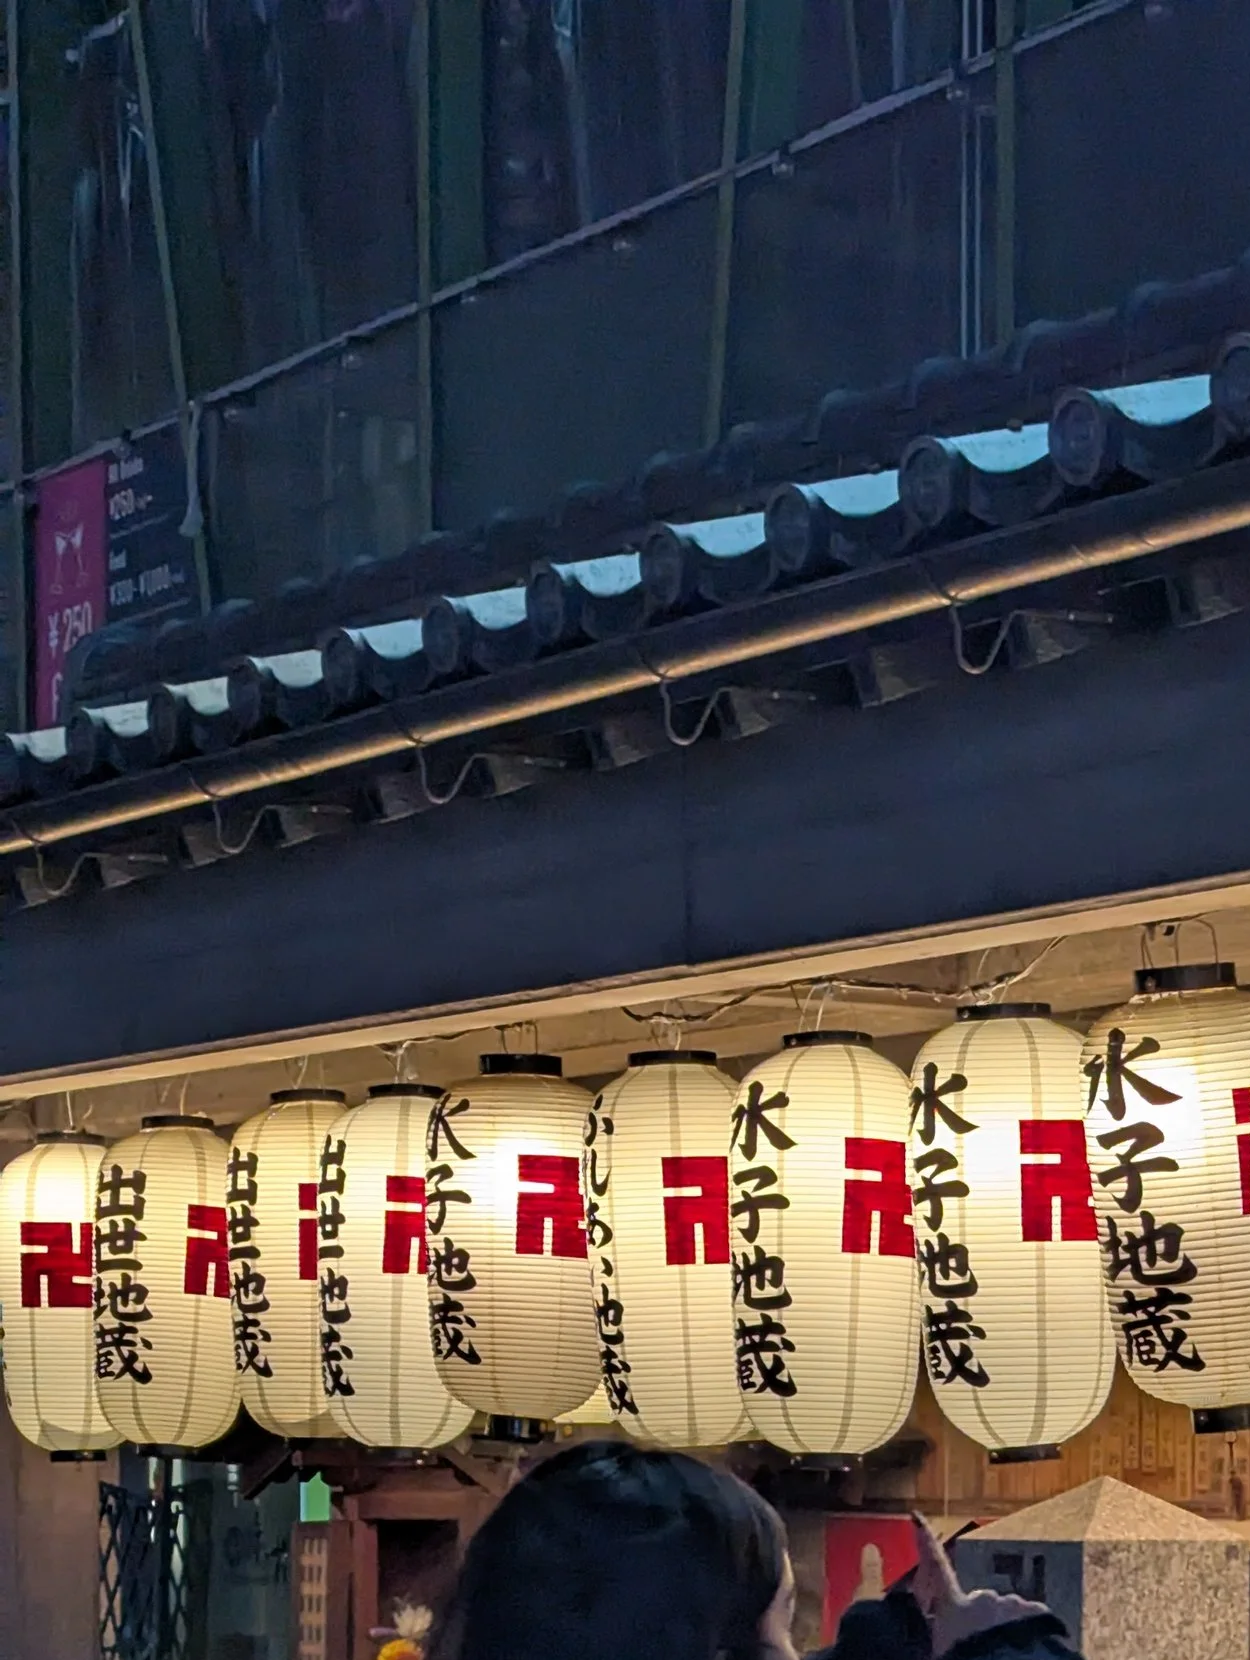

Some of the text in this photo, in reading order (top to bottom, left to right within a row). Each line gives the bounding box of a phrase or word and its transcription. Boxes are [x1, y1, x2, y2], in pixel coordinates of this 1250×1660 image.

[94, 1163, 154, 1385] 出世地蔵
[730, 1081, 799, 1398] 水子地蔵
[908, 1061, 991, 1389] 水子地蔵
[1085, 1027, 1207, 1373] 水子地蔵
